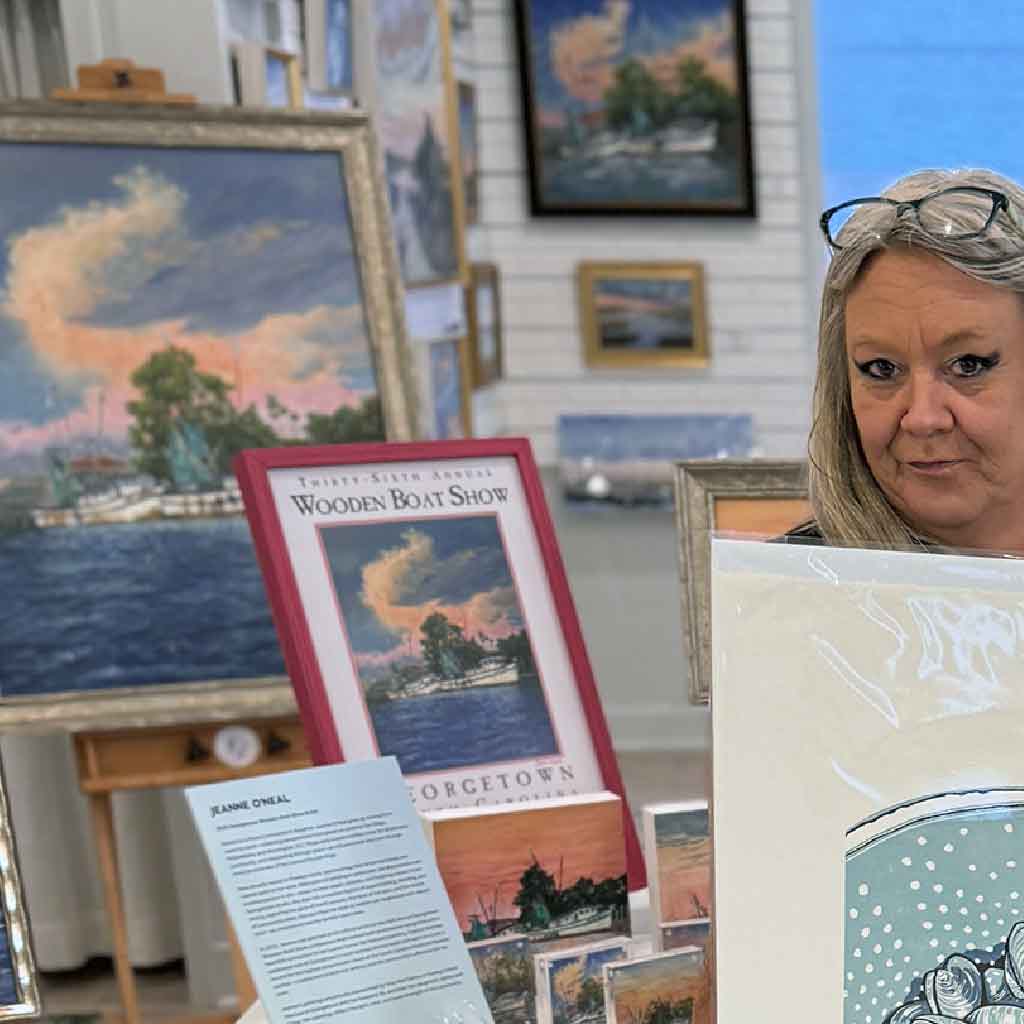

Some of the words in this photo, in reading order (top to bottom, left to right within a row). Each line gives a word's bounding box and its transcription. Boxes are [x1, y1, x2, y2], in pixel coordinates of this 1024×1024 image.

[290, 494, 388, 516] WOODEN
[390, 487, 444, 511] BOAT
[449, 484, 509, 507] SHOW
[409, 765, 576, 804] ORGETOWN
[210, 799, 251, 818] JEANNE
[252, 794, 291, 809] O'NEAL
